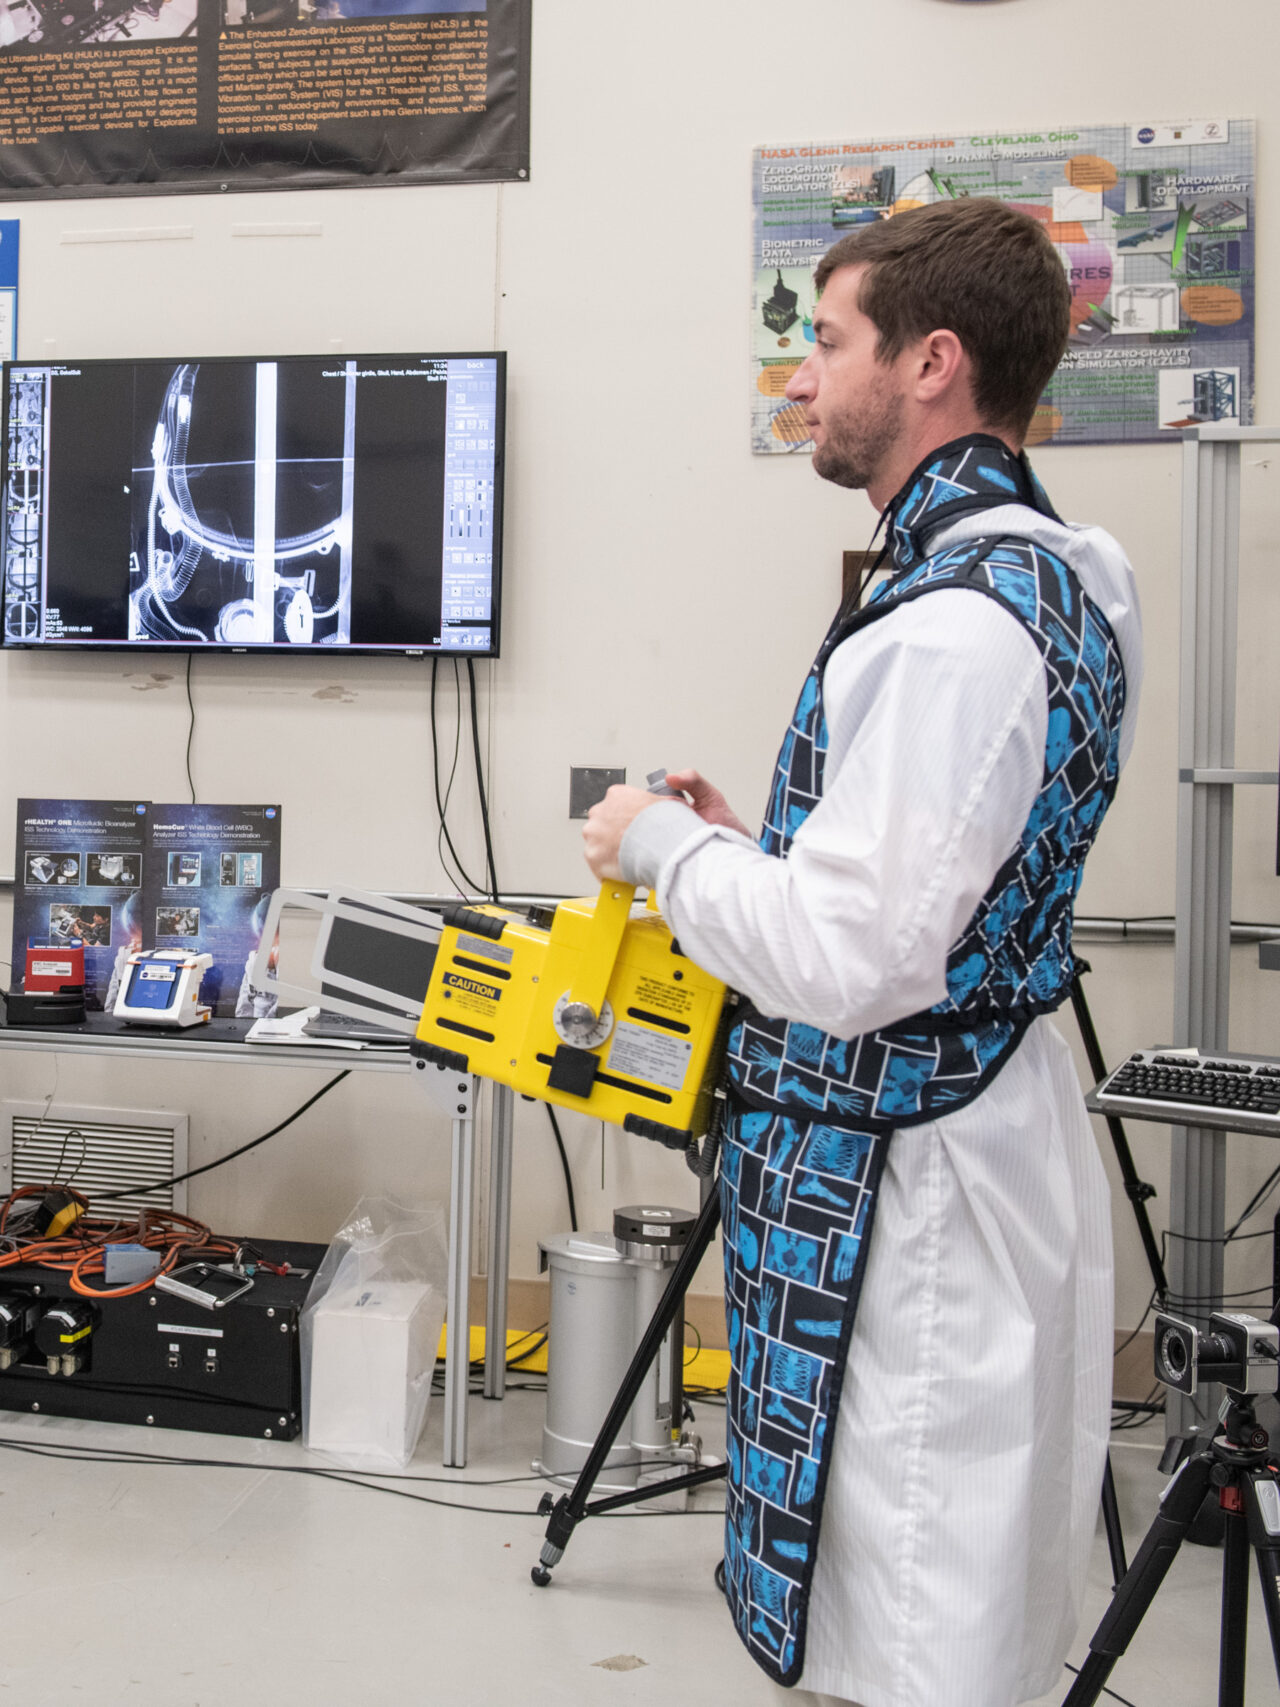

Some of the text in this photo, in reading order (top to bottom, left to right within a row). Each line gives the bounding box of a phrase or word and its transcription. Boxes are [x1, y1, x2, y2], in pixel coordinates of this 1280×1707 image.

[230, 31, 244, 40] The
[247, 28, 286, 38] Enhanced
[288, 25, 338, 36] Zero-Gravity
[340, 23, 387, 34] Locomotion
[389, 20, 428, 31] Simulator
[254, 37, 322, 49] Countermeasures
[324, 35, 366, 47] Laboratory
[421, 30, 456, 41] treadmill
[458, 30, 477, 39] used
[9, 54, 38, 64] Ultimate
[74, 51, 102, 60] (HULK)
[119, 49, 153, 58] prototype
[156, 45, 197, 55] Exploration
[218, 114, 251, 124] exercise
[252, 112, 287, 123] concepts
[290, 112, 304, 121] and
[306, 110, 348, 121] equipment
[350, 109, 369, 118] such
[383, 107, 396, 116] the
[398, 106, 422, 116] Glenn
[761, 148, 796, 160] NASA
[1061, 350, 1102, 361] ANCED
[449, 976, 495, 998] CAUTION
